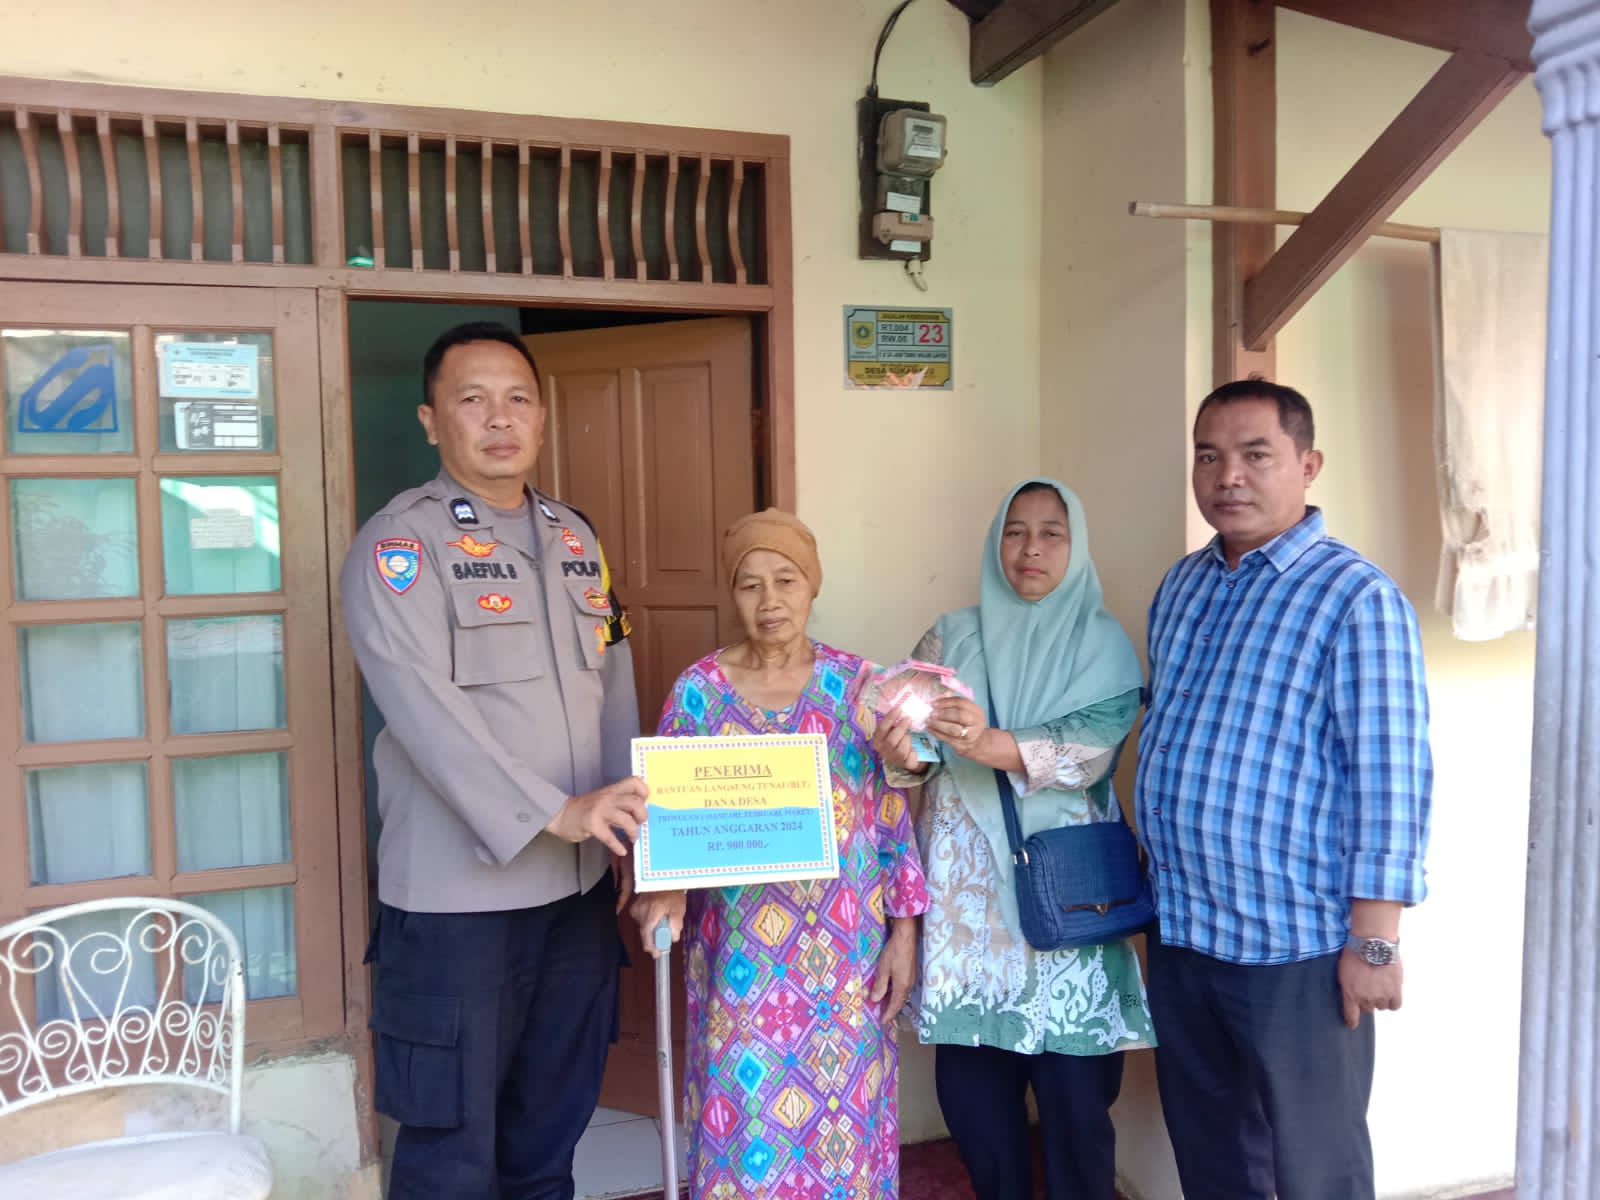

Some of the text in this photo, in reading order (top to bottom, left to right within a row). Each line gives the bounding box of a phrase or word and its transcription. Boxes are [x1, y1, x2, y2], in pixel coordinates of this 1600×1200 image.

[919, 323, 943, 343] 23
[561, 560, 601, 578] POLR
[694, 764, 773, 779] PENERIMA
[656, 784, 701, 795] BANTUAN
[704, 781, 755, 793] LANGSUNG
[757, 780, 786, 791] TUNAI
[703, 795, 768, 808] DANA DESA
[671, 819, 804, 837] TAHUN ANGGARAN 2024
[707, 840, 726, 851] RP.
